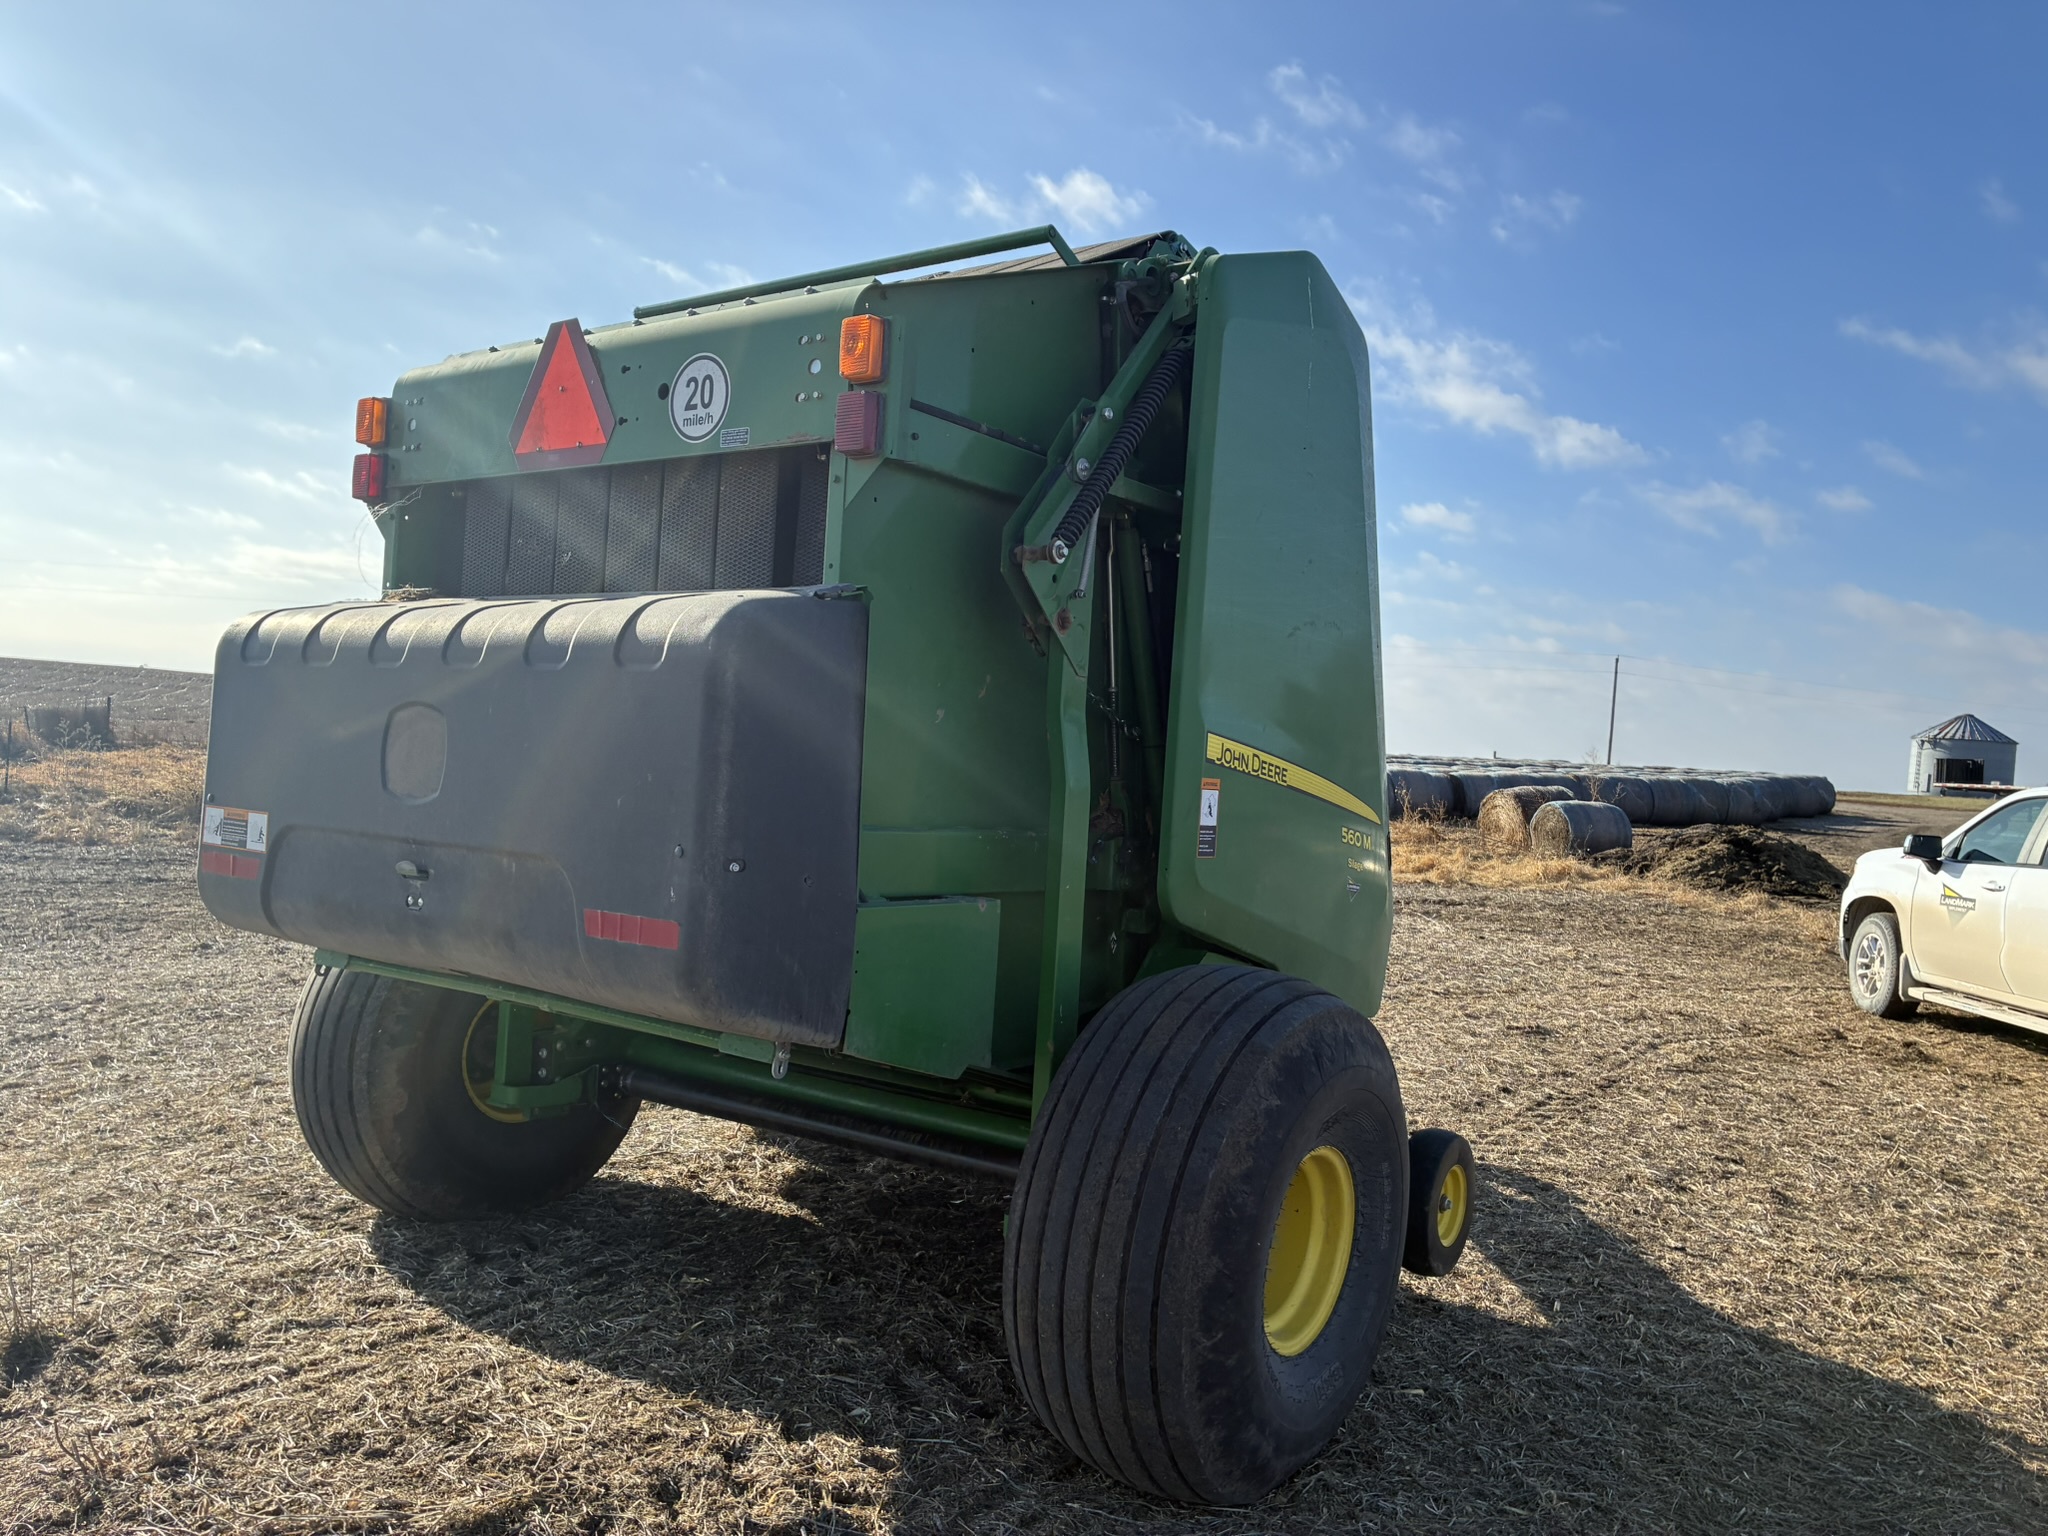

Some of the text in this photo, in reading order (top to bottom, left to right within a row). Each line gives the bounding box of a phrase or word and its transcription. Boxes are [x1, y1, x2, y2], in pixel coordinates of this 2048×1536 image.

[684, 374, 714, 411] 20
[682, 412, 714, 428] mile/h
[1216, 743, 1288, 784] JOHN DEERE
[1341, 826, 1372, 851] 560 M
